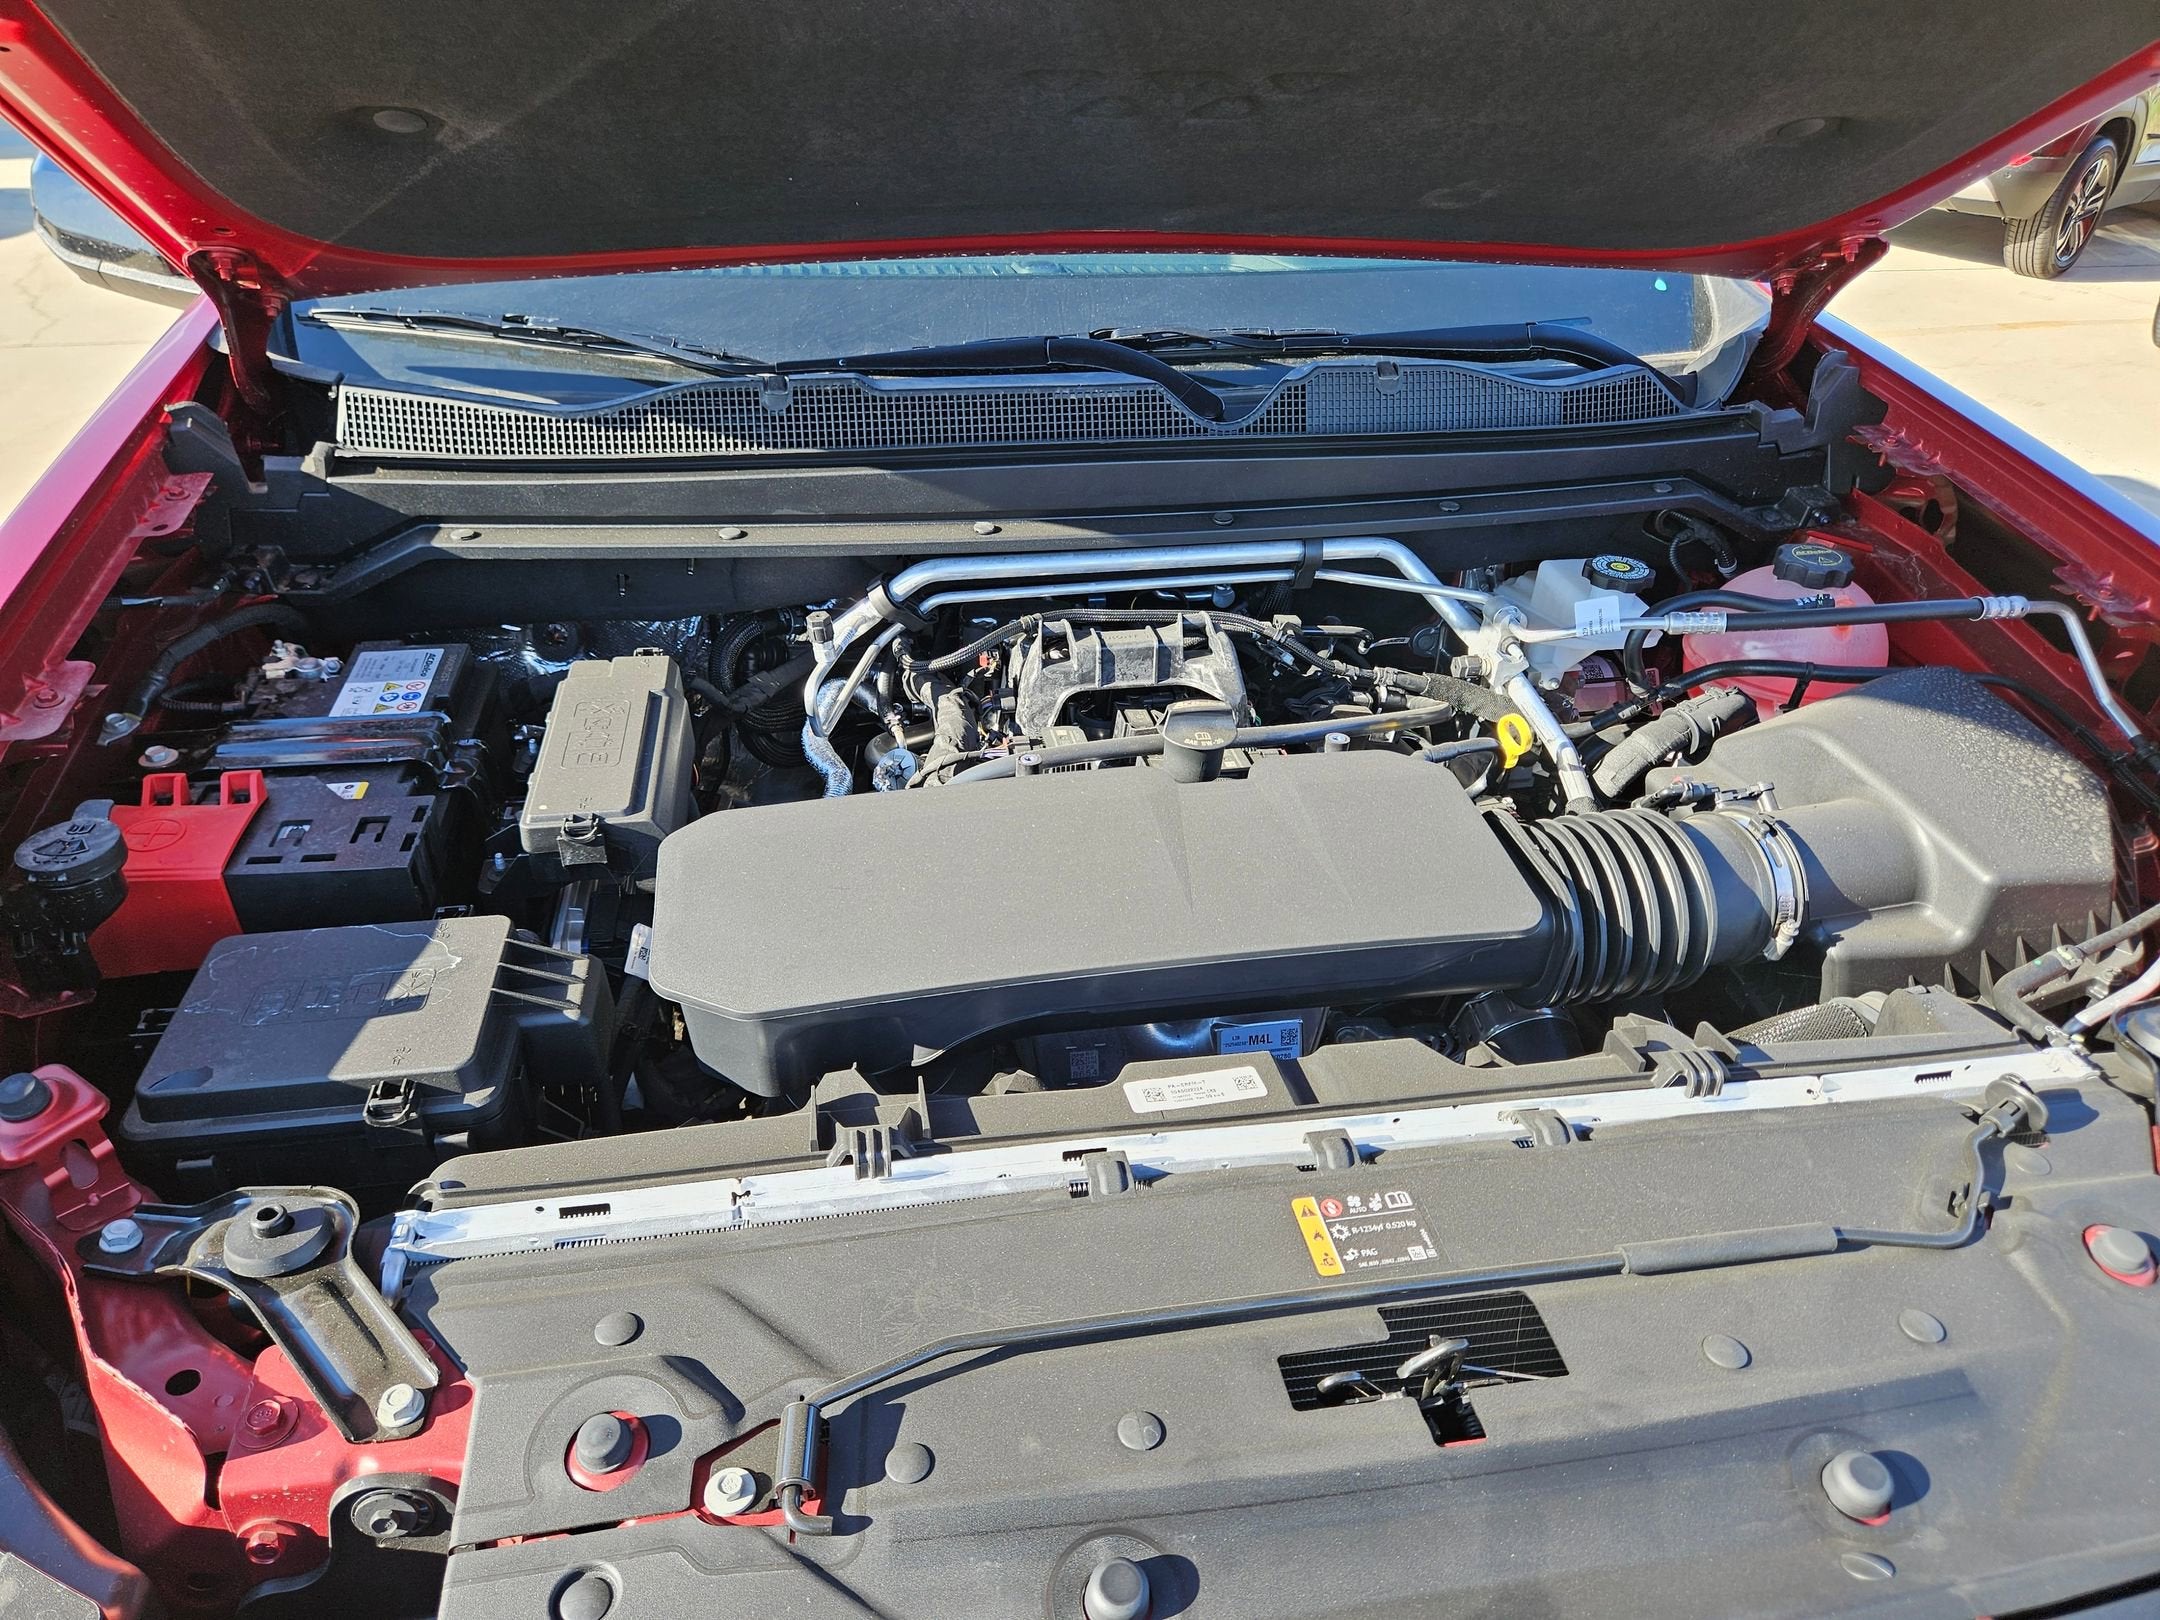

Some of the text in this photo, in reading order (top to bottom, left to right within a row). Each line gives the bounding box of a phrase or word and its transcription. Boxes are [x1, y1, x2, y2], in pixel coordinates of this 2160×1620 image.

[1248, 1034, 1273, 1046] M4L
[1385, 1221, 1405, 1230] 0.520
[1406, 1220, 1417, 1229] kg
[1361, 1248, 1378, 1257] PAG
